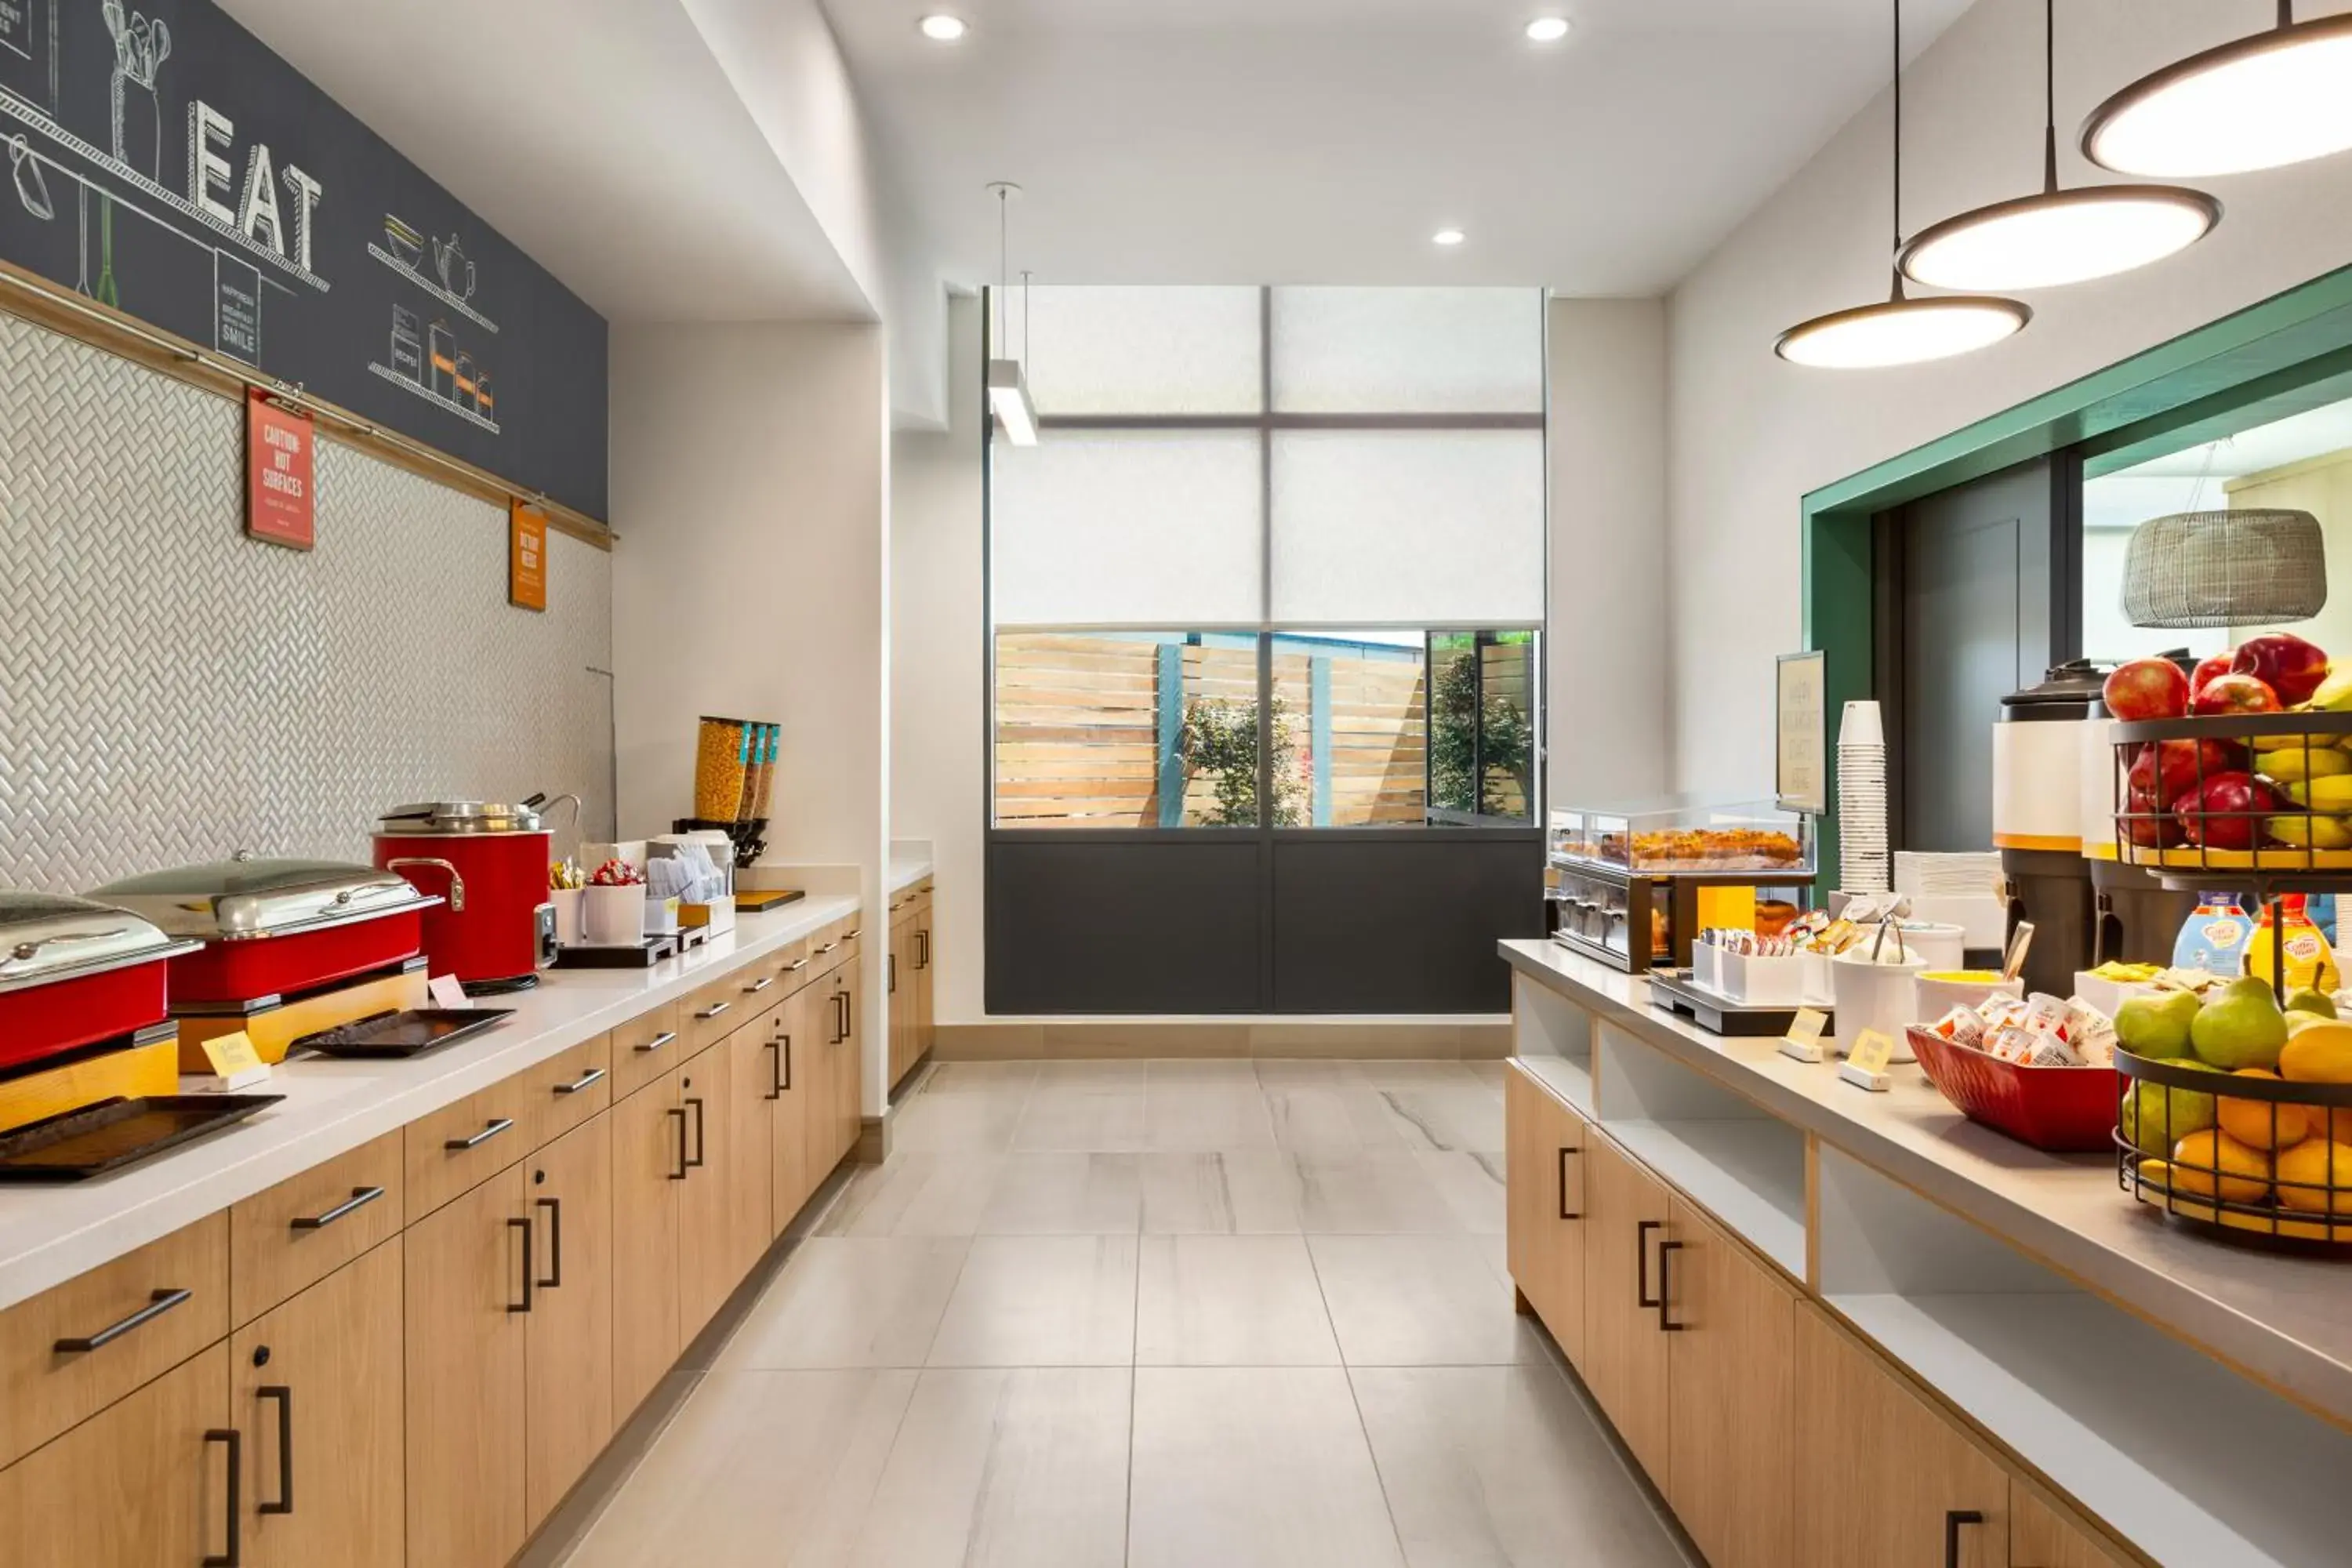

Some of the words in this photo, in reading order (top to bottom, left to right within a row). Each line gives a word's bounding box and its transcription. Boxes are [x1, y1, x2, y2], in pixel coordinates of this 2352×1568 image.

[187, 100, 322, 271] EAT
[222, 324, 255, 353] SMILE
[274, 449, 290, 472] HOT
[263, 467, 303, 498] SURFACES
